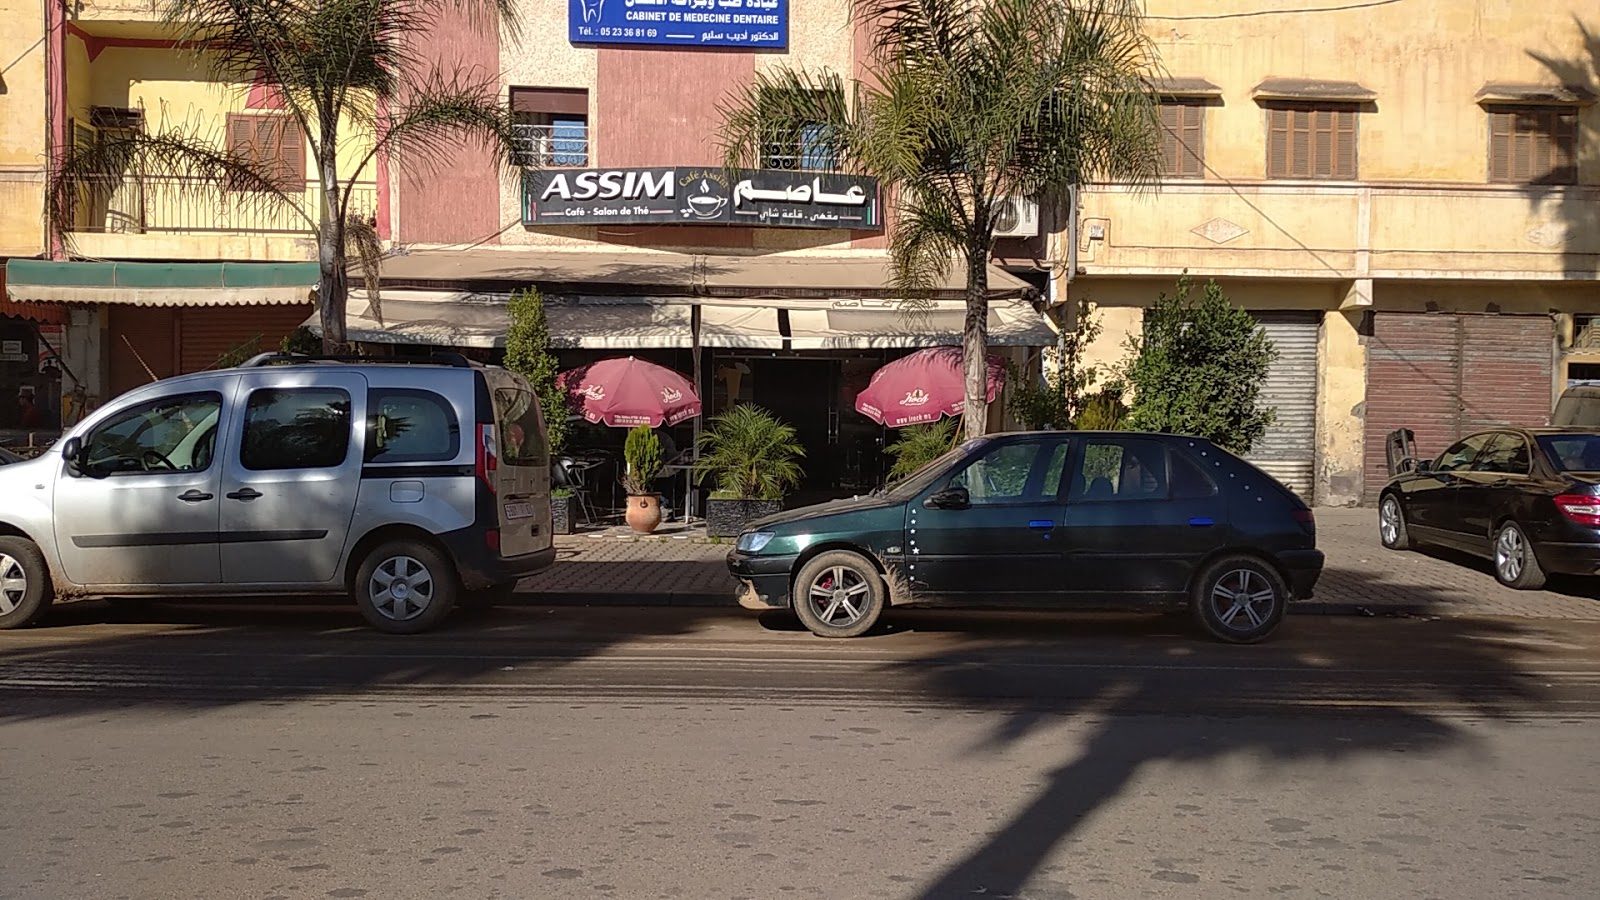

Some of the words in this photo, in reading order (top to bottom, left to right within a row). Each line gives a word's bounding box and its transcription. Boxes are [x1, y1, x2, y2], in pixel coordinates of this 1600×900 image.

[626, 11, 666, 21] CABINET
[669, 12, 682, 22] DE
[684, 13, 731, 23] MEDECINE
[733, 15, 779, 25] DENTAIRE
[600, 27, 611, 36] 05
[612, 28, 622, 37] 23
[624, 28, 634, 37] 36
[635, 28, 645, 37] 81
[647, 29, 657, 37] 69
[750, 31, 779, 42] الدكتور
[541, 171, 675, 200] ASSIM
[679, 170, 700, 187] Café
[733, 176, 866, 208] عاصم
[565, 206, 585, 216] Café
[593, 206, 618, 216] Salon
[620, 206, 631, 215] de
[633, 206, 649, 215] Thé
[759, 207, 780, 221] شاي
[809, 211, 839, 222] مقهى
